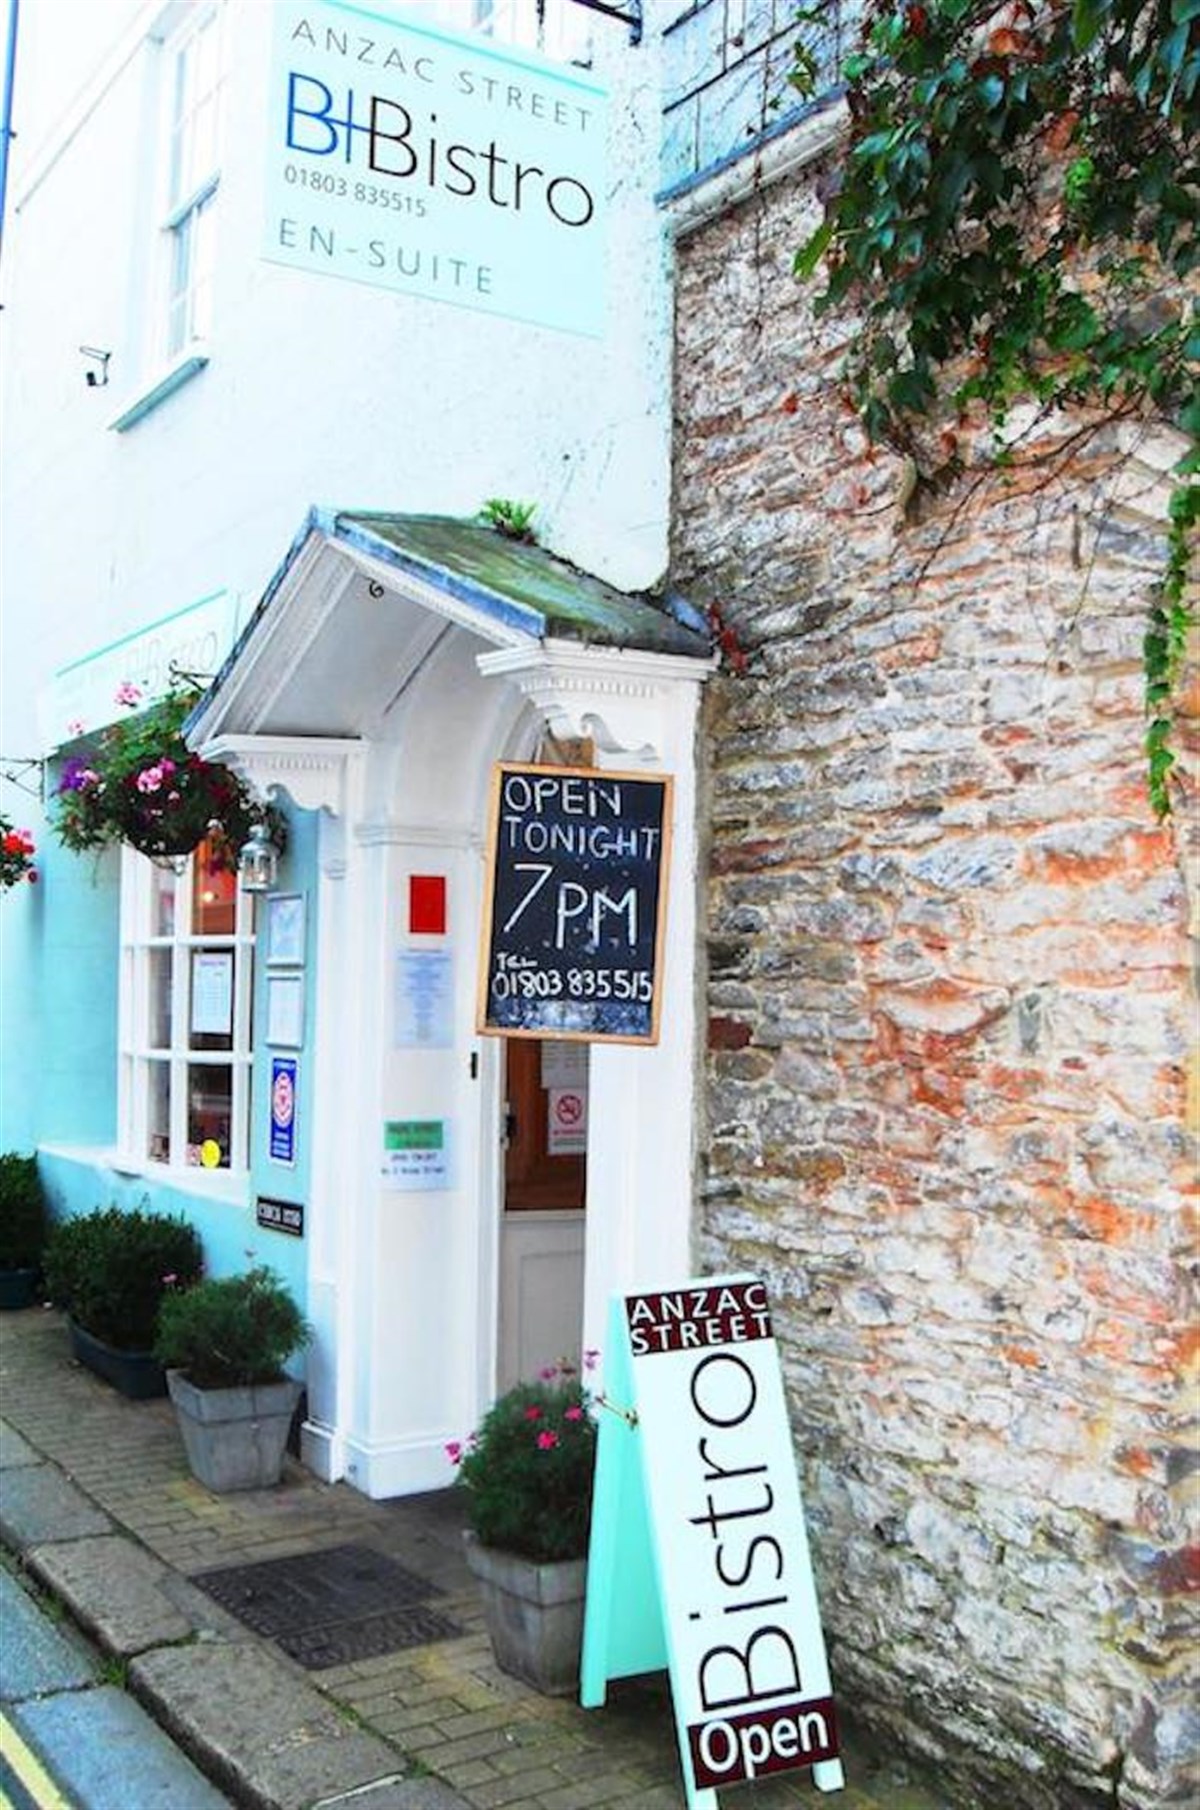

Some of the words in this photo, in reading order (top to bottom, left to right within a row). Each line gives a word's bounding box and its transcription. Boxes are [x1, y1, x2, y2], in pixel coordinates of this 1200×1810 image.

[291, 19, 435, 83] ANZAC
[457, 71, 592, 131] STREET
[284, 165, 347, 197] 01803
[354, 184, 426, 217] 835515
[280, 218, 493, 294] EN-SUITE
[505, 777, 620, 817] OPEN
[505, 816, 659, 859] TONIGHT
[503, 863, 552, 933] 7
[556, 883, 637, 948] PM
[493, 971, 562, 999] 01803
[567, 968, 652, 1001] 835515
[631, 1285, 766, 1325] ANZAC
[631, 1313, 769, 1354] STREET
[690, 1353, 802, 1711] Bistro
[700, 1711, 829, 1779] Open
